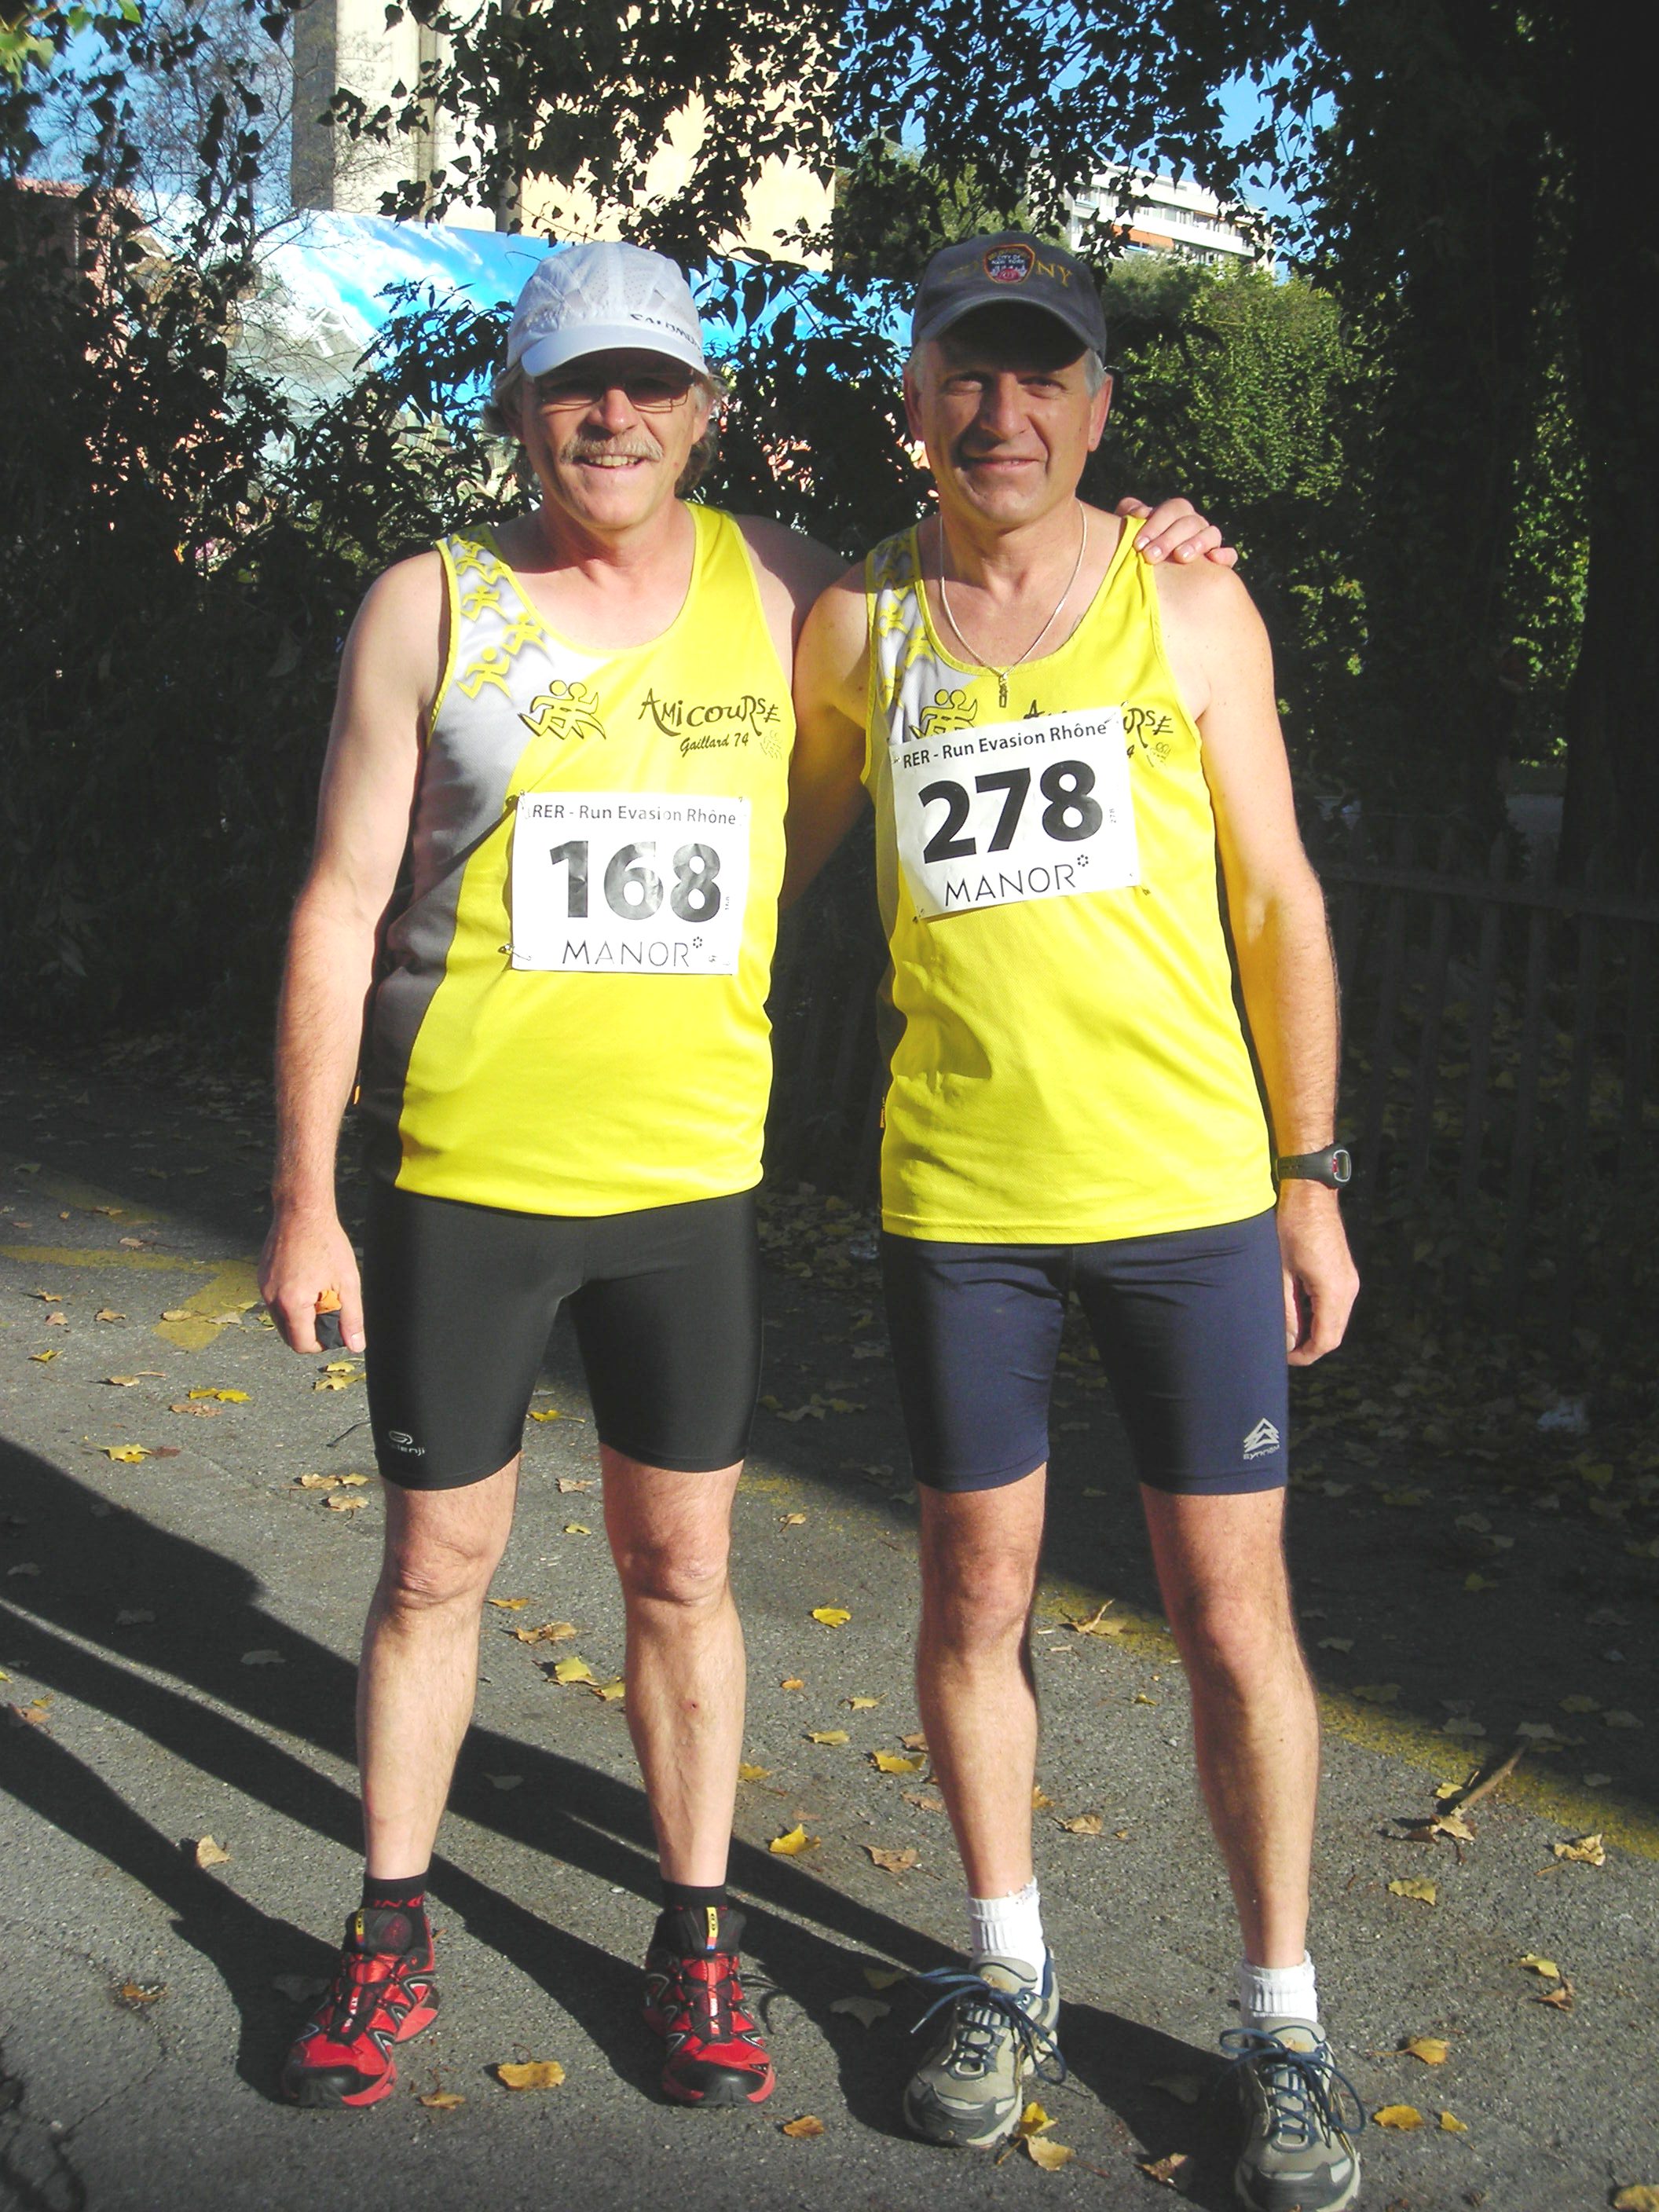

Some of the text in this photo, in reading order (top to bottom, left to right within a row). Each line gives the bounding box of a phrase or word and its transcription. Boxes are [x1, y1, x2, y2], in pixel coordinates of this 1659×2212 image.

[679, 732, 749, 758] Gaillard 74
[903, 749, 931, 769] RER
[943, 742, 975, 759] Run
[979, 731, 1046, 753] Evasion
[1049, 722, 1107, 742] Rhône
[532, 804, 566, 819] RER
[579, 805, 613, 819] Run
[618, 805, 682, 822] Evasion
[687, 808, 737, 825] Rhône
[917, 760, 1104, 865] 278
[549, 840, 721, 923] 168
[944, 863, 1077, 907] MANOR
[562, 939, 690, 968] MANOR
